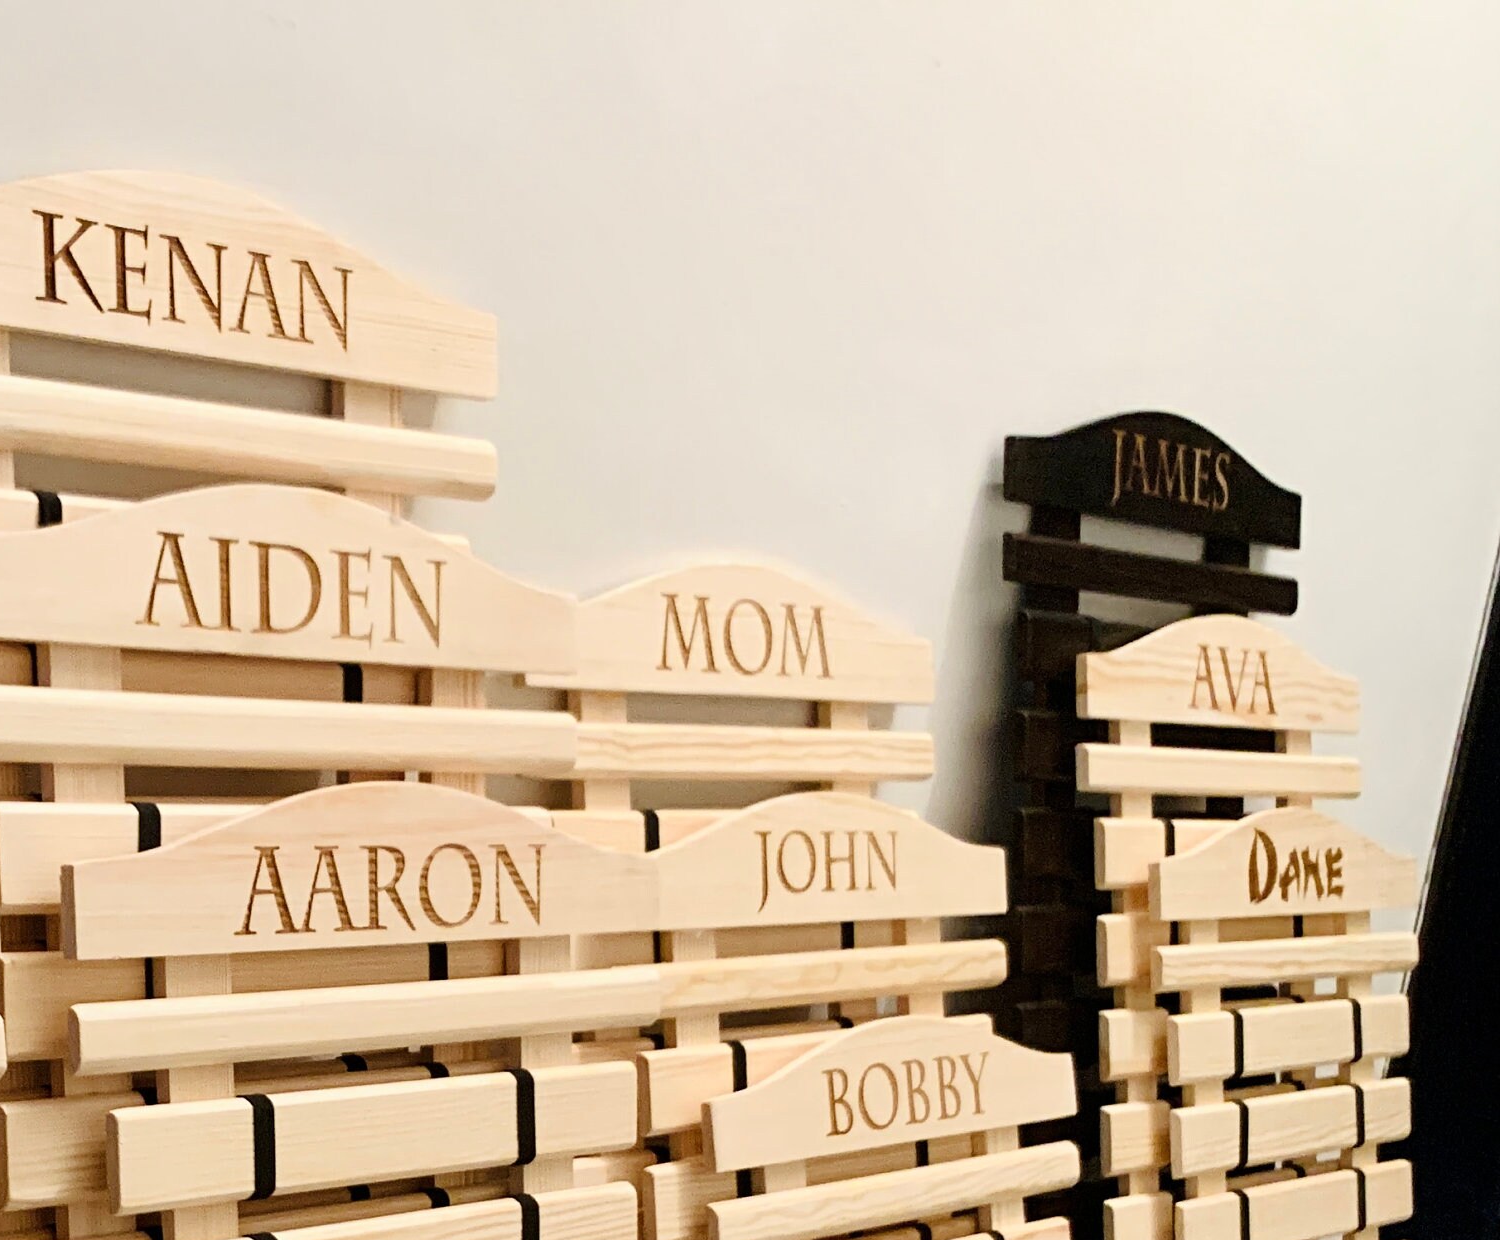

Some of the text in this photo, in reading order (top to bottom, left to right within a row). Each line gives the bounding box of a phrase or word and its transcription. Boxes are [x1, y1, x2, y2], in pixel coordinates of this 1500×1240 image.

[32, 209, 354, 352] KENAN
[1111, 428, 1231, 511] JAMES
[135, 531, 447, 649] AIDEN
[655, 592, 835, 679] MOM
[1188, 644, 1278, 715] AVA
[234, 843, 547, 936] AARON
[754, 830, 898, 913] JOHN
[822, 1051, 989, 1137] BOBBY
